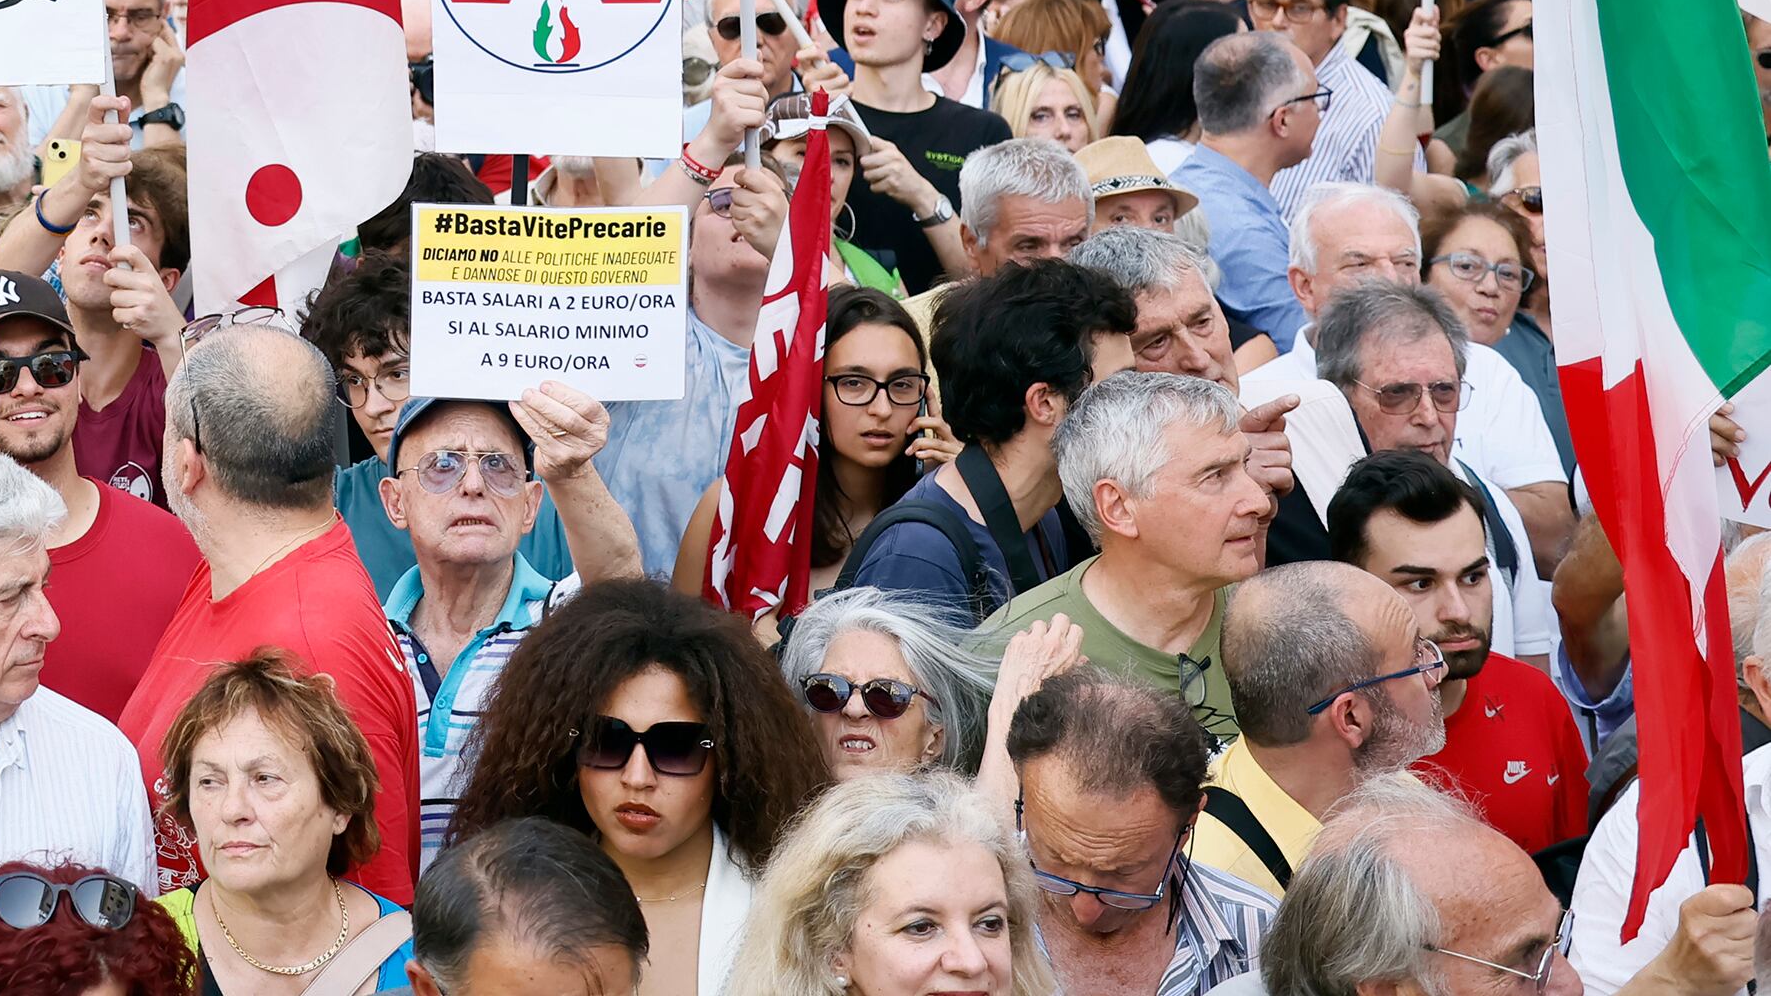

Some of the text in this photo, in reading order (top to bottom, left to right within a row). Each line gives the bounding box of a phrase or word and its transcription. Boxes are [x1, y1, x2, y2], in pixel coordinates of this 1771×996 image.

[434, 212, 667, 240] #BastaVitePrecarie
[422, 247, 678, 267] DICIAMO NO ALLE POLITICHE INADEGUATE
[451, 266, 649, 286] E DANNOSE DI QUESTO GOVERNO
[422, 290, 677, 312] BASTA SALARI A 2 EURO/ORA
[447, 320, 650, 340] SI AL SALARIO MINIMO
[480, 353, 611, 373] A 9 EURO/ORA
[1506, 760, 1527, 774] NIKE
